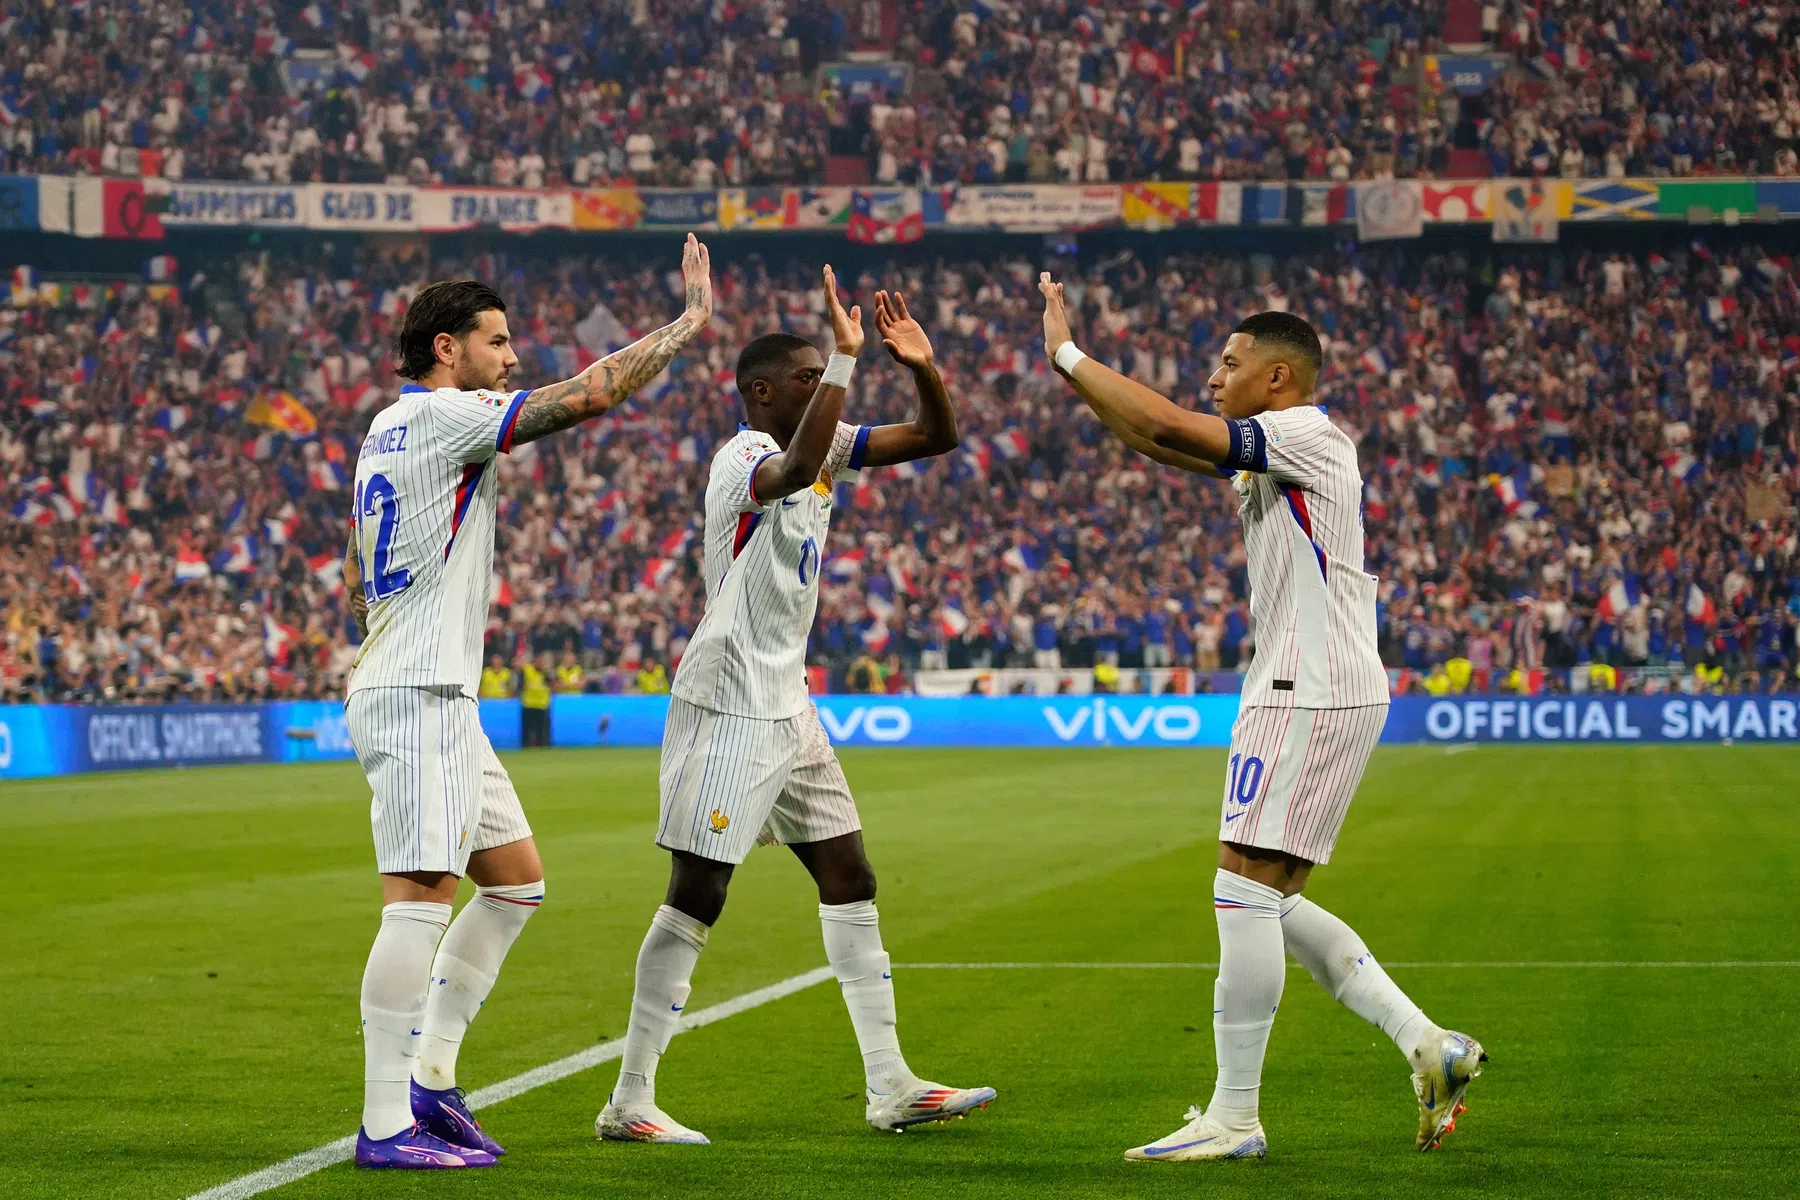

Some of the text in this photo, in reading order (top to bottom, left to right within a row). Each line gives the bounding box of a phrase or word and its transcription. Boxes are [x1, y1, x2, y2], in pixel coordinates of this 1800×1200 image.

[1241, 426, 1253, 463] RESPECT
[818, 704, 912, 742] vo
[1042, 697, 1202, 741] vivo
[1424, 699, 1800, 740] OFFICIAL SMAR
[1228, 752, 1265, 807] 10
